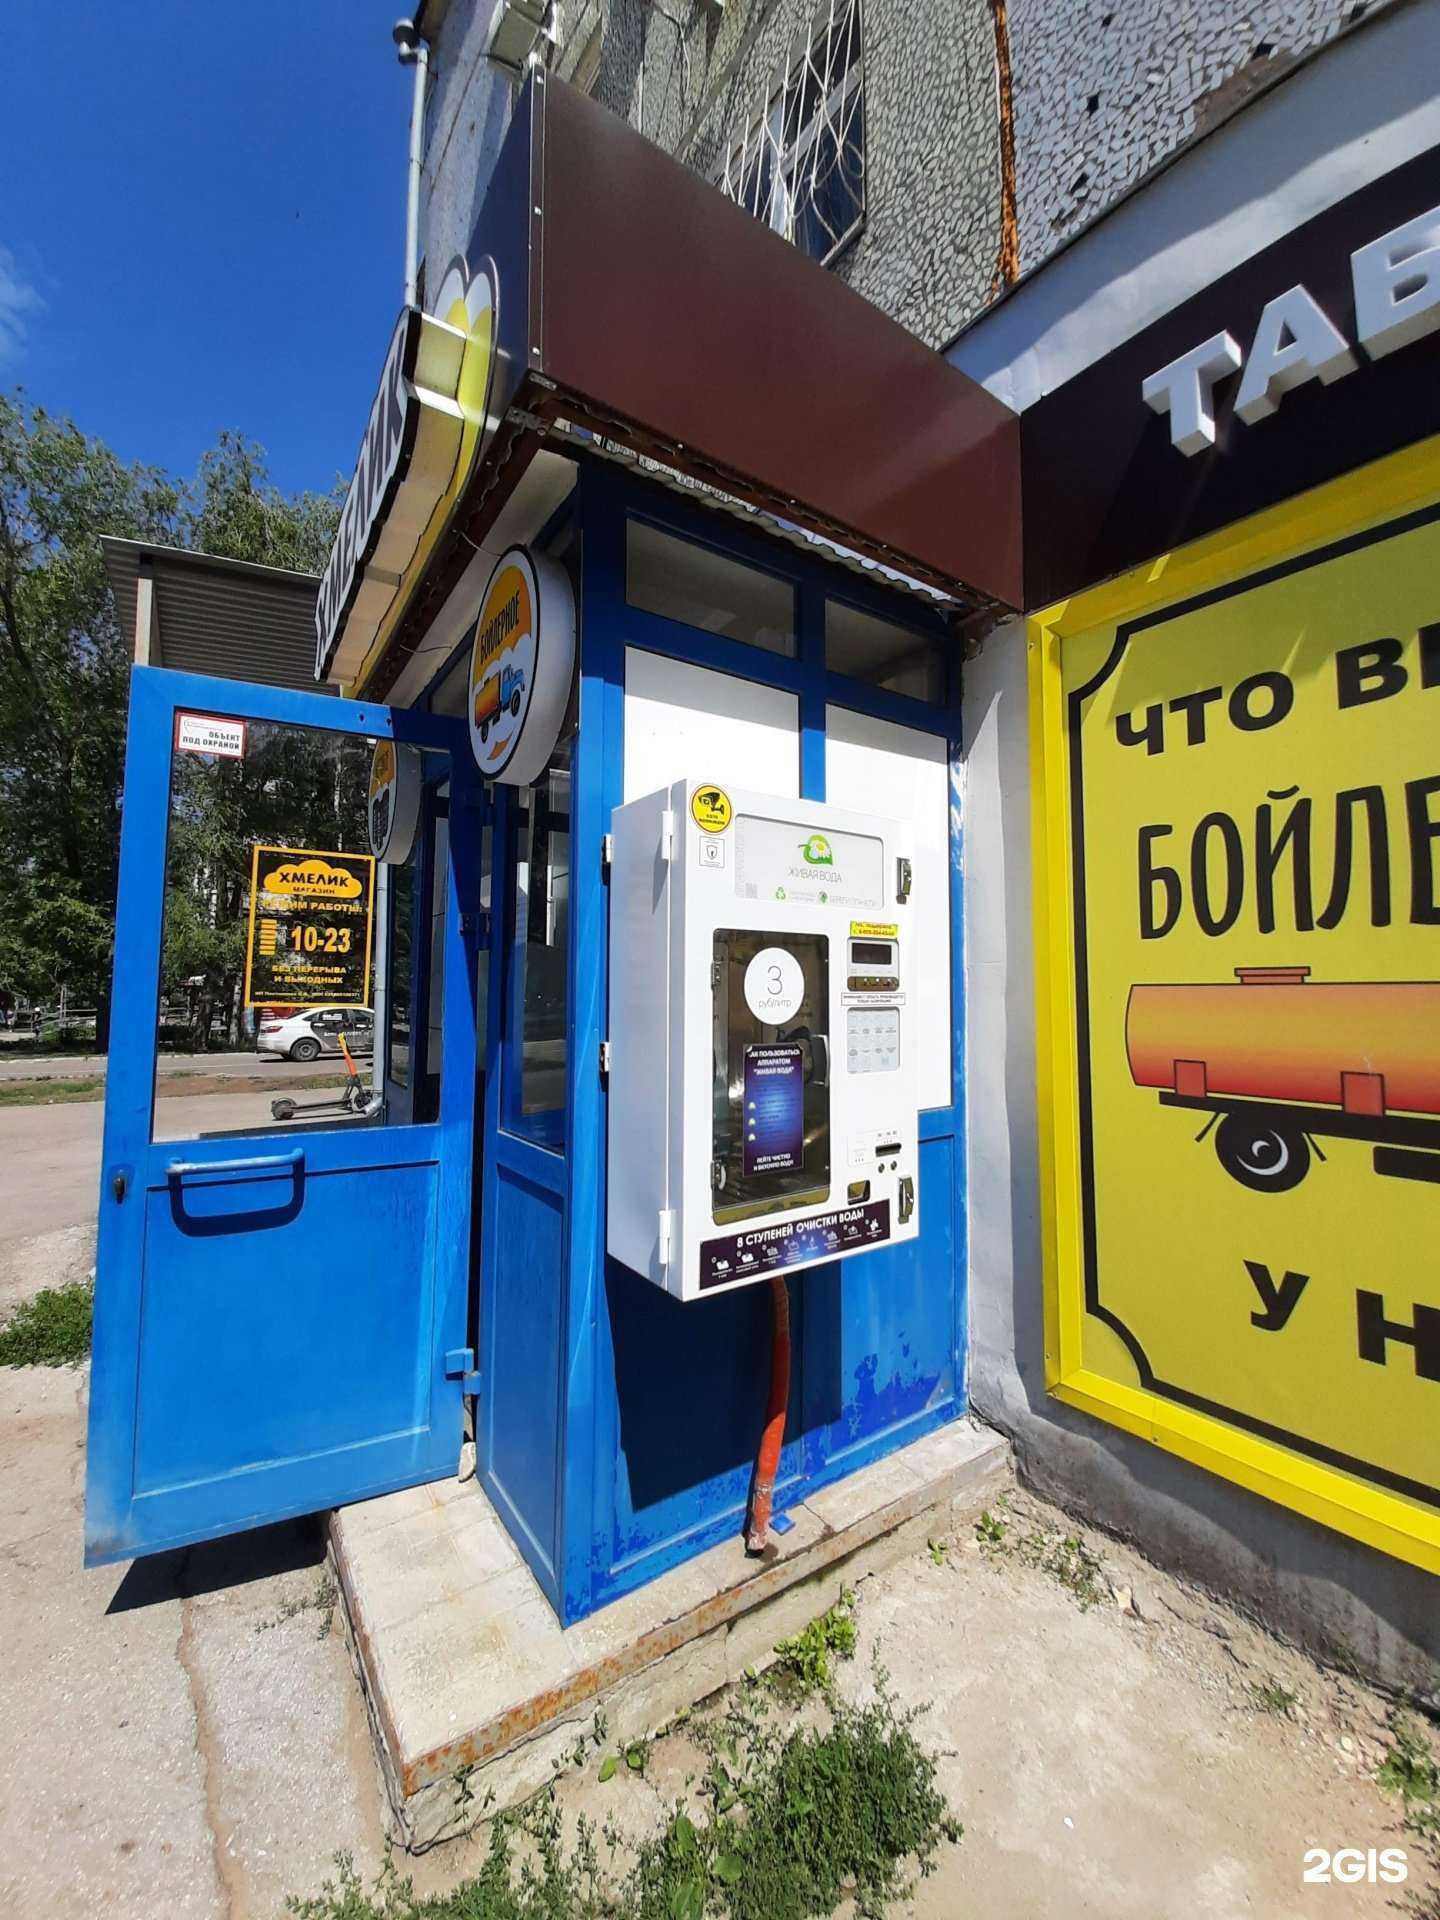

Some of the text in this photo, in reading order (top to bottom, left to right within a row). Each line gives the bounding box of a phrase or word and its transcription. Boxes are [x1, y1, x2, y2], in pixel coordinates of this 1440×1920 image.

[1142, 205, 1440, 456] ТАБ
[1115, 671, 1295, 756] ЧТО
[182, 735, 240, 750] ПОД ОХРАНОЙ
[208, 731, 240, 741] ОБЪЕКТ
[1138, 774, 1440, 940] БОЙЛЕ
[279, 872, 350, 887] ХМЕЛИК
[292, 886, 335, 895] МАГАЗИН
[819, 869, 842, 884] ВОДА
[291, 925, 351, 953] 10-23
[293, 964, 347, 974] ПЕРЕРЫВА
[767, 965, 783, 996] 3
[736, 1208, 865, 1248] 8 СТУПЕНЕЙ ОЧИСТКИ ВОДЫ
[1243, 1259, 1310, 1332] У
